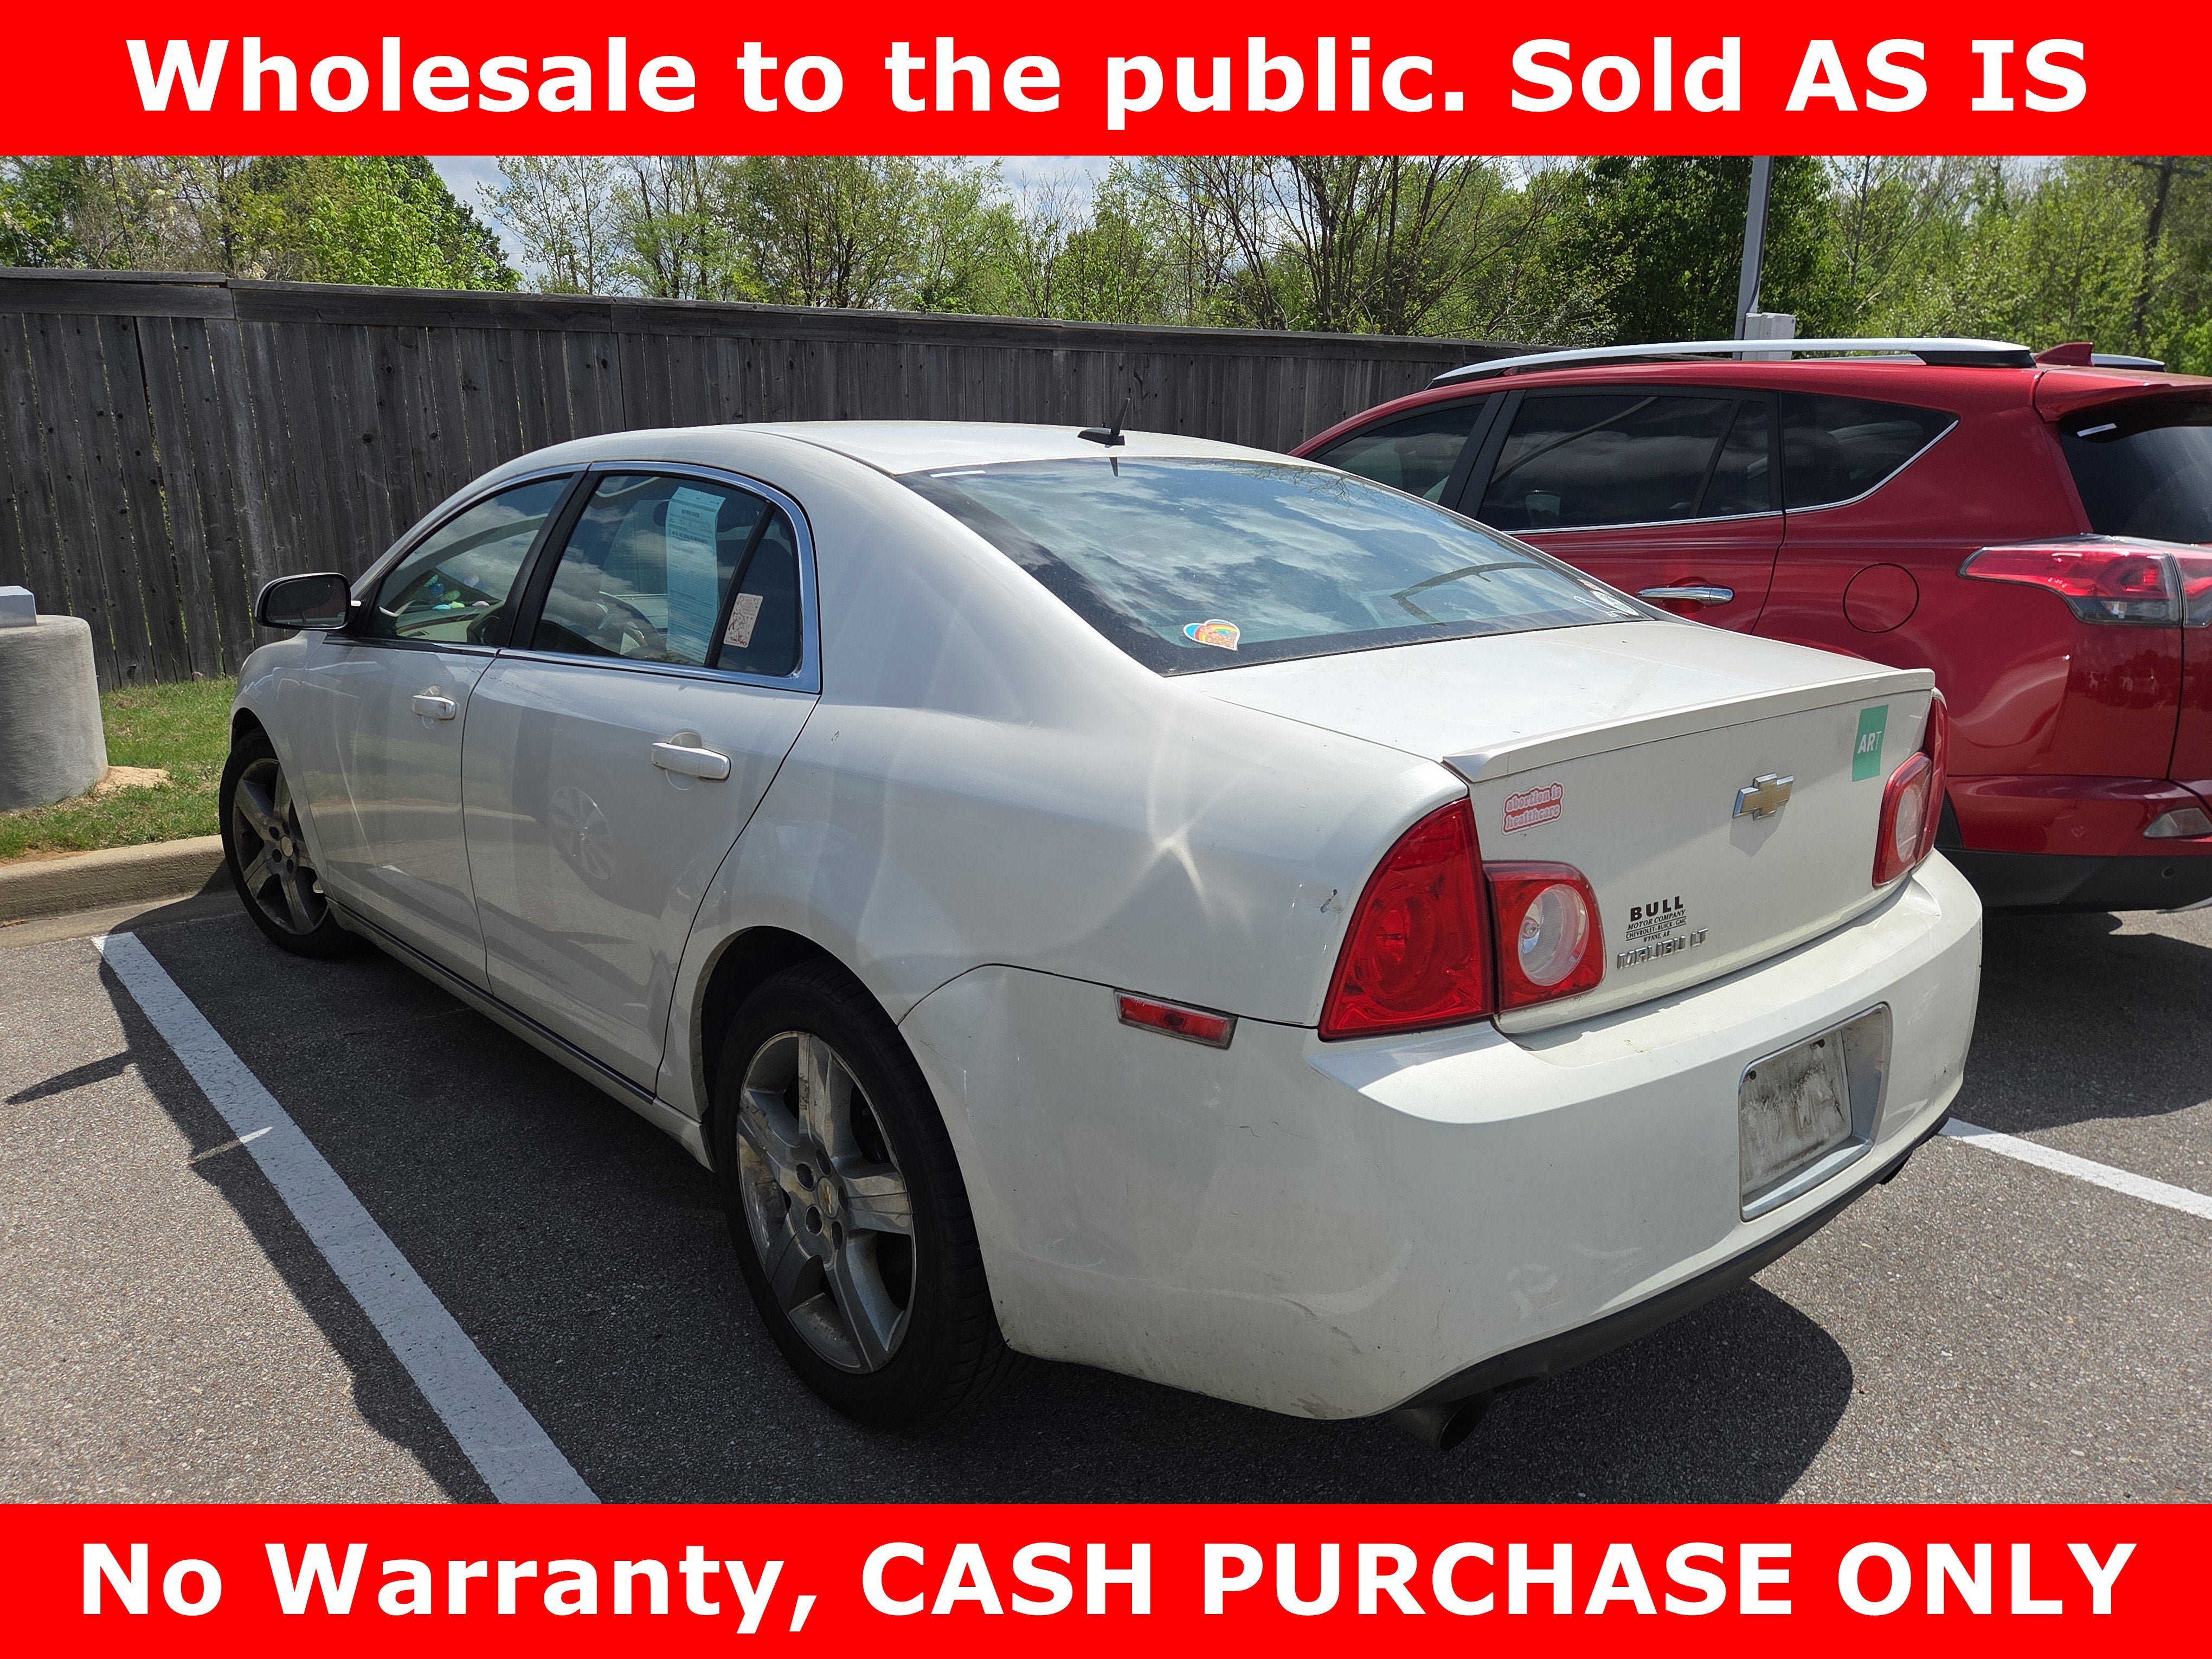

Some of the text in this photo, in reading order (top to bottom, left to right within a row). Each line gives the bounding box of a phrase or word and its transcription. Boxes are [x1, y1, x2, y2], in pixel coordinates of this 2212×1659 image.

[1858, 731, 1882, 754] ART
[1507, 787, 1561, 811] abortion is
[1506, 805, 1559, 828] healthcare
[1628, 910, 1686, 930] MOTOR COMPANY
[1630, 896, 1683, 922] BULL
[1617, 928, 1708, 969] MALIBU LT
